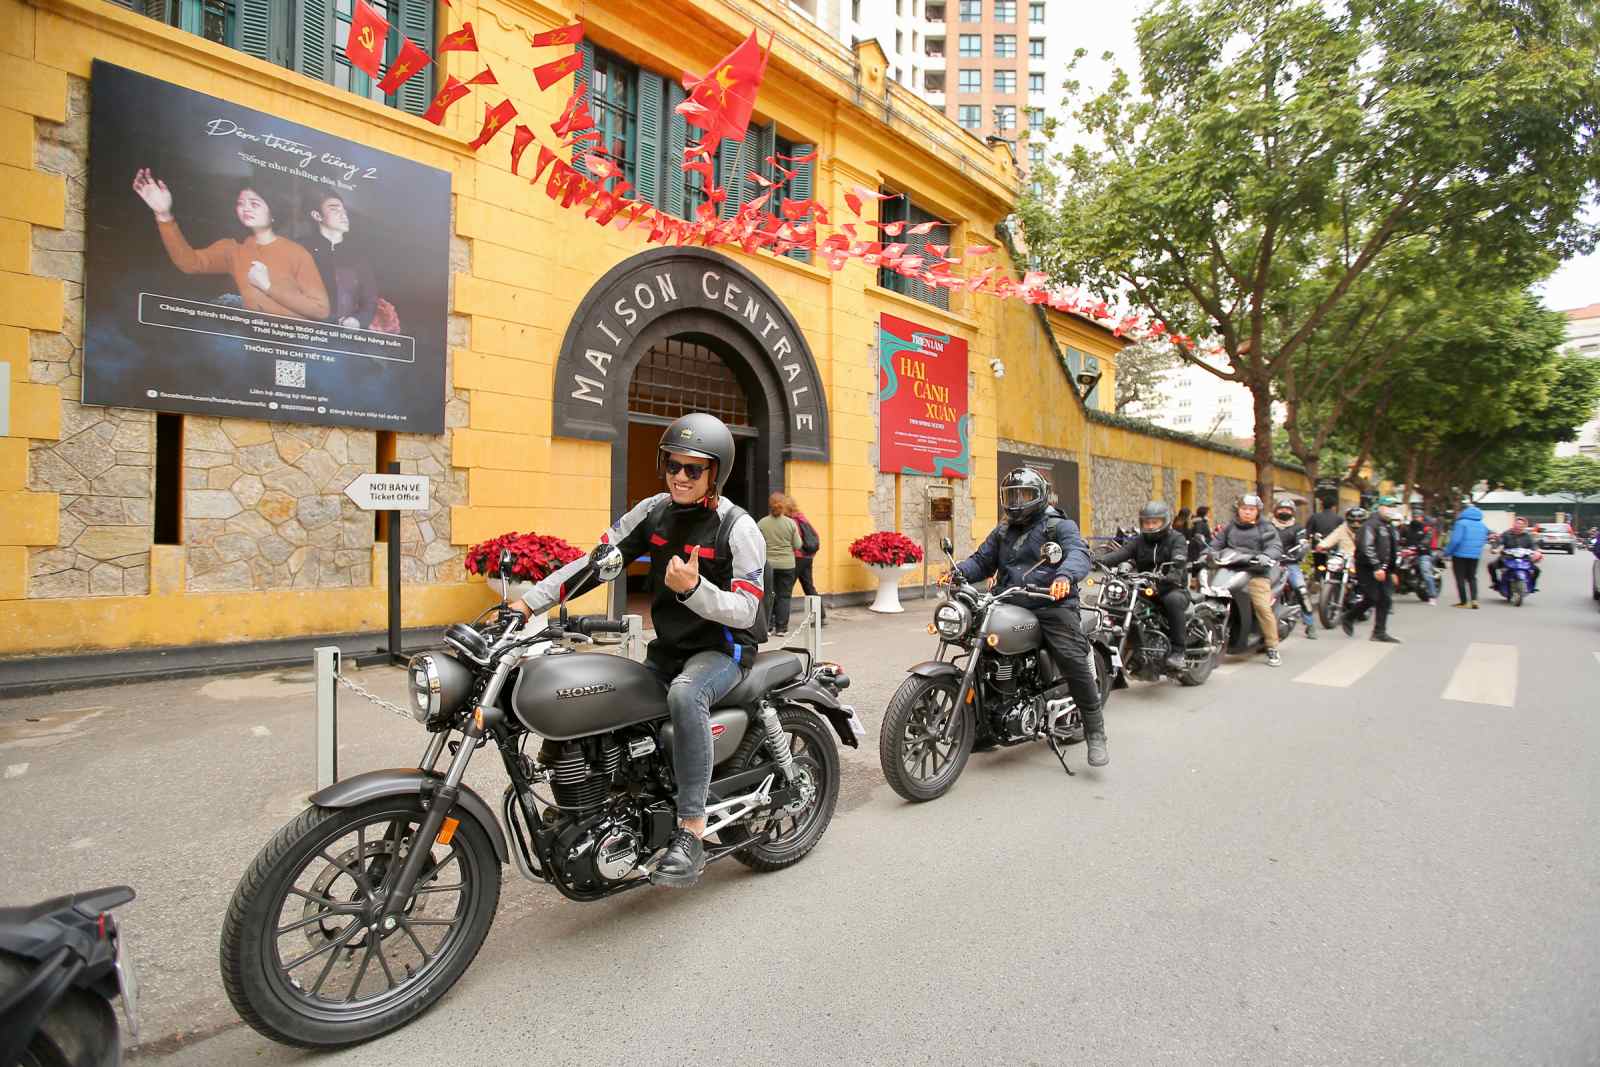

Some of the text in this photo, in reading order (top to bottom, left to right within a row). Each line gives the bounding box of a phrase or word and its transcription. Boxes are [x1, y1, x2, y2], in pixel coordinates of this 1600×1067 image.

[207, 118, 377, 181] Đêm thiêng liêng 2
[160, 303, 196, 316] Chương
[197, 309, 218, 319] trình
[219, 312, 251, 325] thường
[243, 343, 274, 354] THÔNG
[275, 348, 288, 356] TIN
[289, 350, 304, 358] CHI
[571, 271, 813, 432] MAISON CENTRALE
[900, 356, 926, 380] HAI
[913, 377, 949, 404] CẢNH
[926, 402, 957, 423] XUÂN
[369, 482, 387, 491] NƠI
[370, 493, 420, 501] Ticket Office
[556, 682, 617, 700] HONDA
